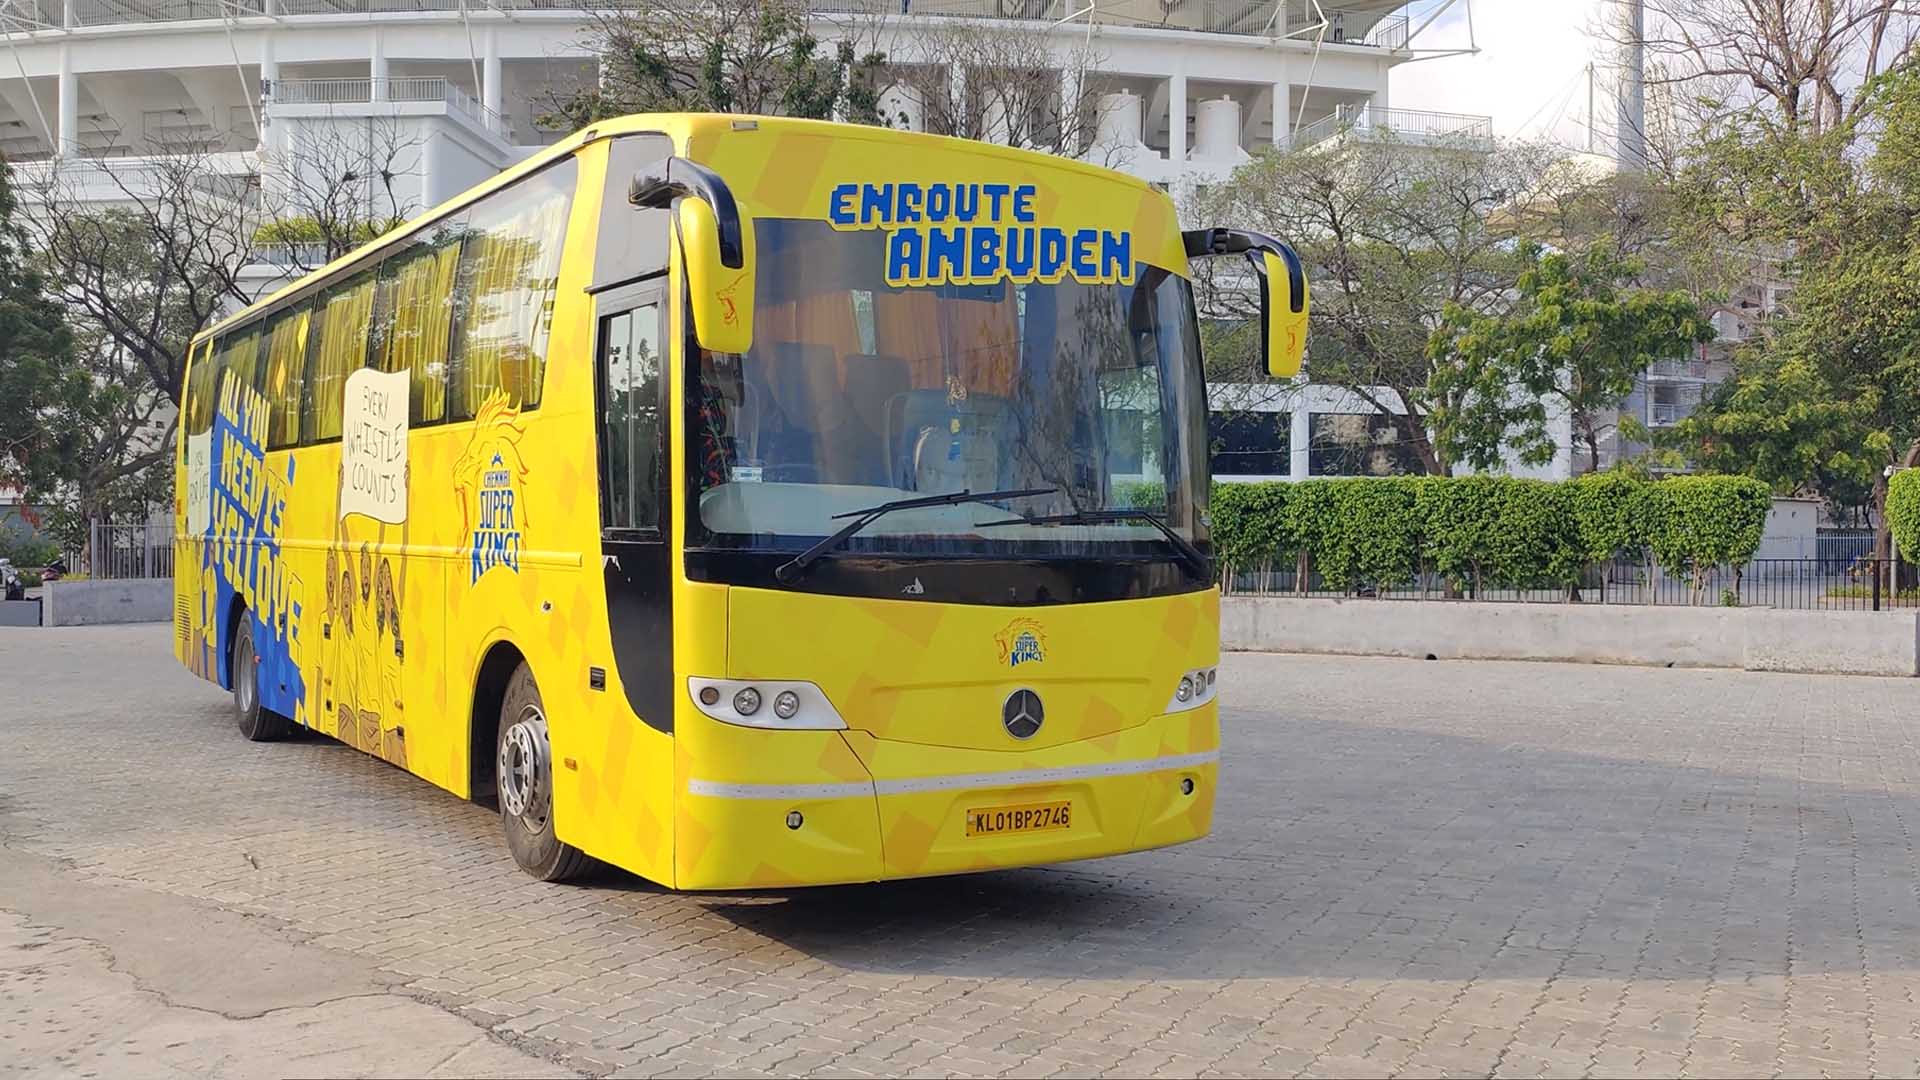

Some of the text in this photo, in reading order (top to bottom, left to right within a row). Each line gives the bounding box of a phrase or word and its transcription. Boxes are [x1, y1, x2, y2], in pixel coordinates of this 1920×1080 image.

[829, 183, 1036, 225] ENROUTE
[888, 227, 1131, 280] ANBUDEN
[219, 366, 271, 453] ALL YOU
[362, 385, 389, 421] EVERY
[347, 420, 403, 464] WHISTLE
[220, 427, 266, 520] NEED
[352, 462, 397, 505] COUNTS
[479, 489, 515, 530] SUPER
[213, 487, 304, 672] YELLOVE
[471, 530, 521, 587] KINGS
[1011, 651, 1043, 667] KINGS
[1015, 640, 1039, 652] SUPER
[975, 806, 1070, 833] KL01BP2746
